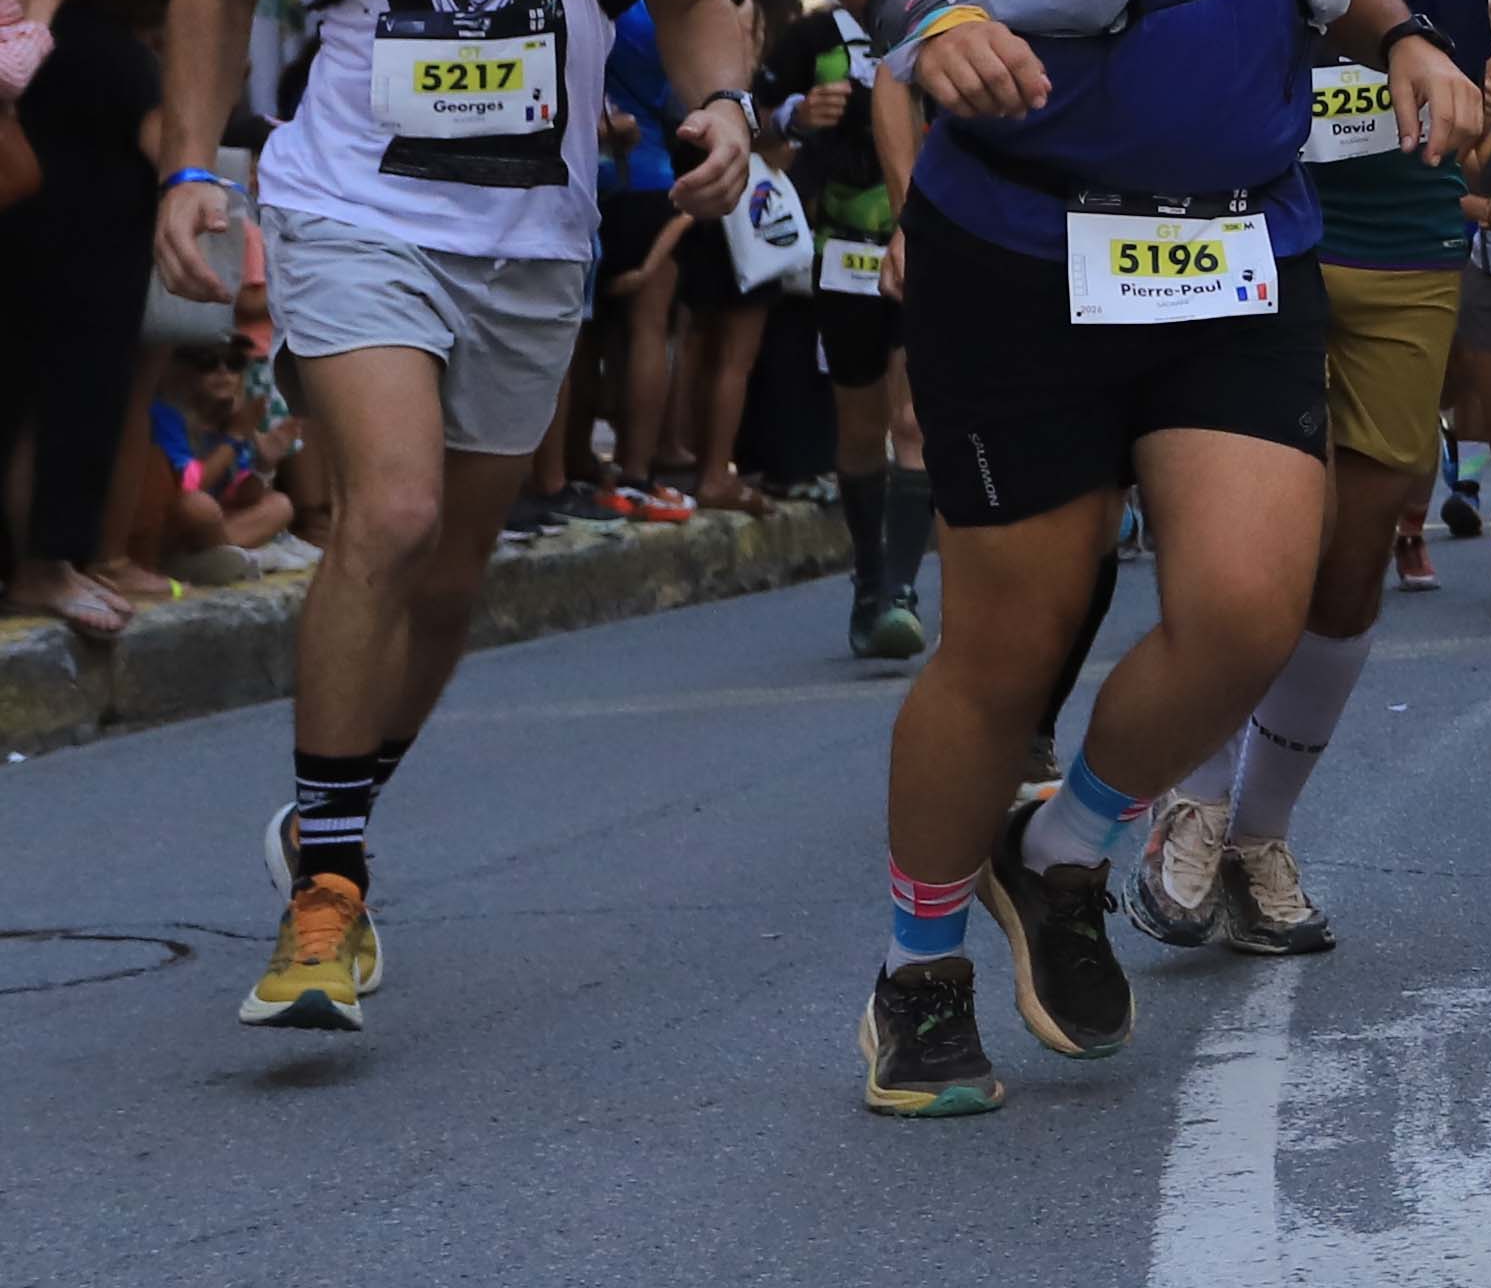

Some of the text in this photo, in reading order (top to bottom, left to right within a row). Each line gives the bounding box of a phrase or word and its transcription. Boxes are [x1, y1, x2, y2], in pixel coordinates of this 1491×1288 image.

[420, 62, 518, 91] 5217
[433, 100, 505, 116] Georges
[1312, 85, 1393, 117] 5250
[1332, 119, 1376, 136] David
[1118, 243, 1219, 275] 5196
[1120, 278, 1222, 298] Pierre-Paul
[967, 431, 1001, 507] SALOMON
